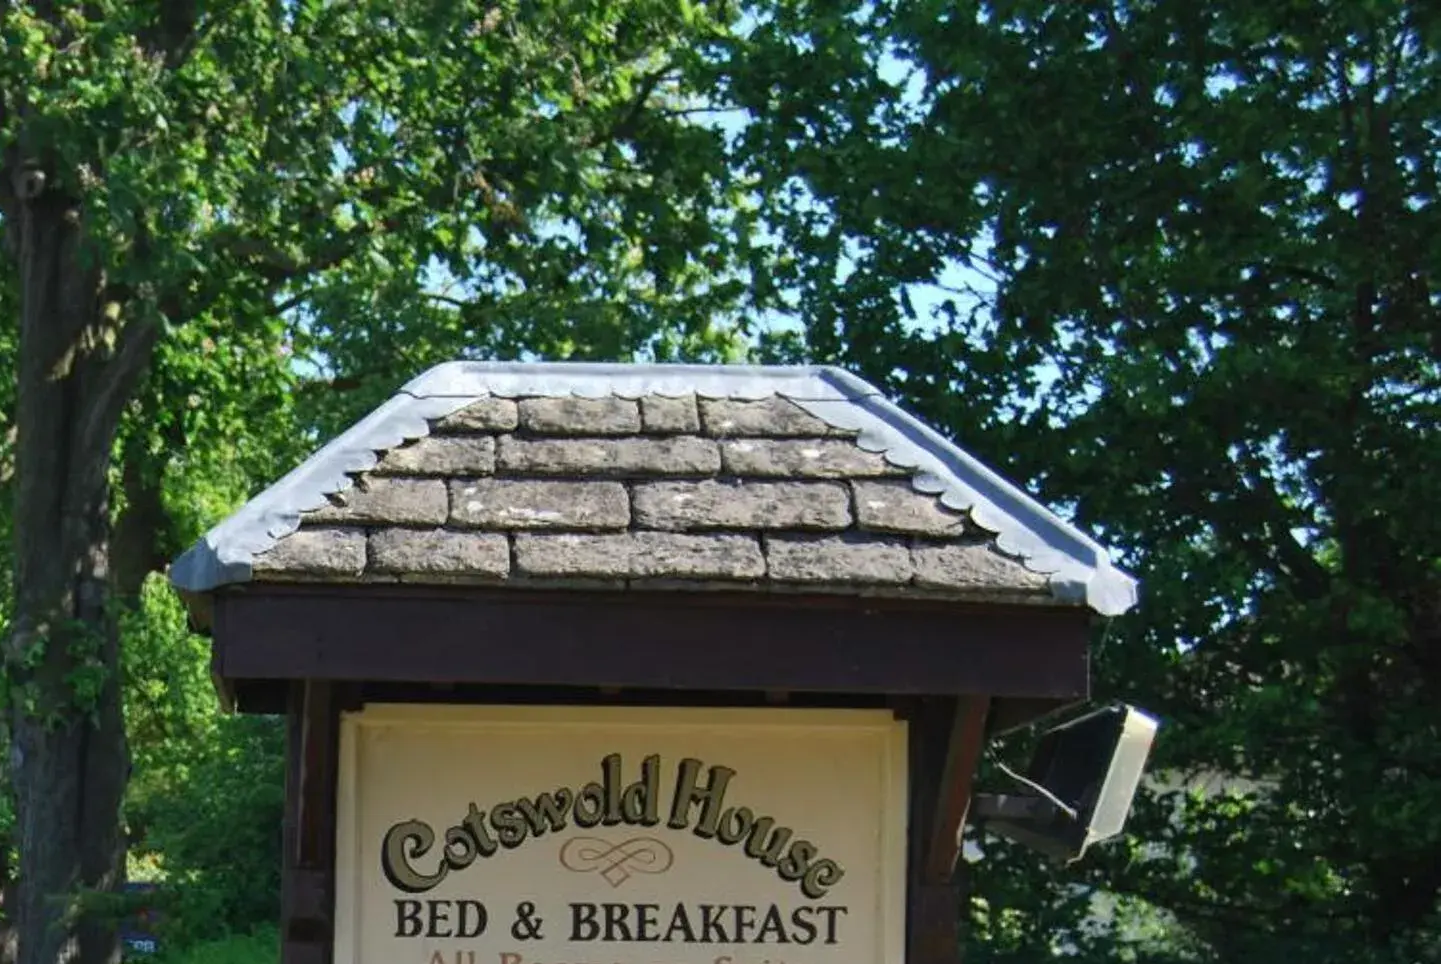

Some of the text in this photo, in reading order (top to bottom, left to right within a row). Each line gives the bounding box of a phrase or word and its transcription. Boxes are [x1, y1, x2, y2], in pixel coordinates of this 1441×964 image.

[381, 753, 844, 899] Cotswold House
[394, 900, 848, 945] BED & BREAKFAST
